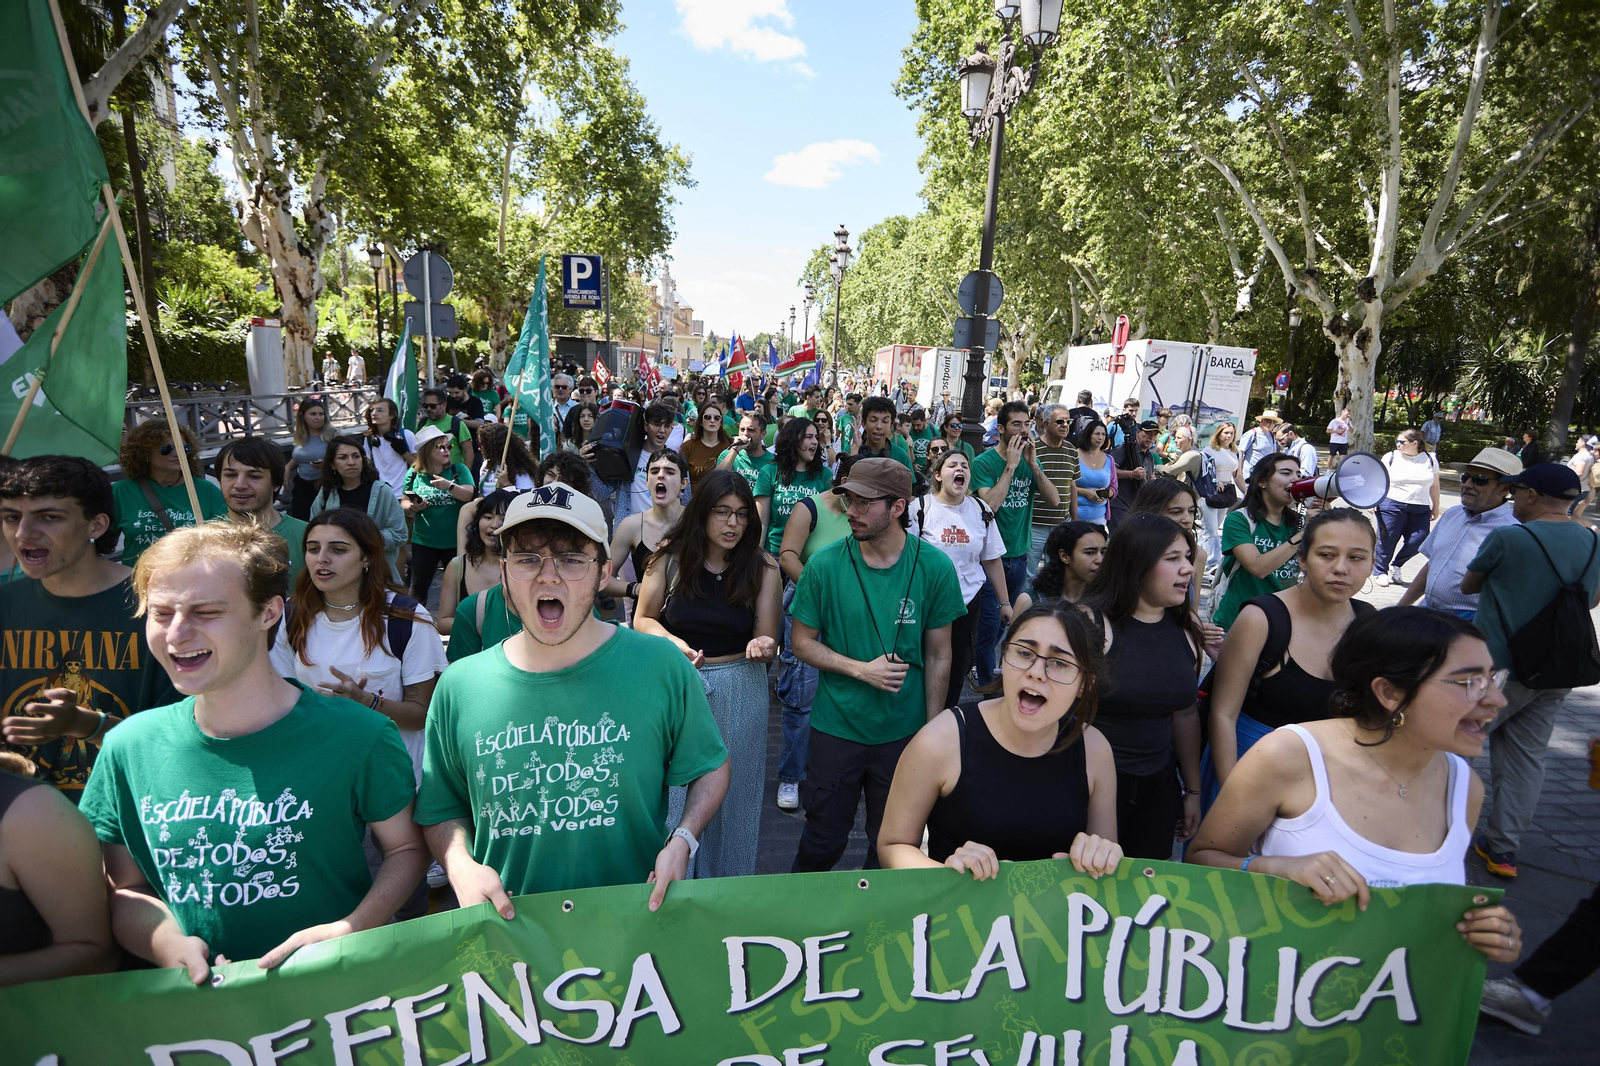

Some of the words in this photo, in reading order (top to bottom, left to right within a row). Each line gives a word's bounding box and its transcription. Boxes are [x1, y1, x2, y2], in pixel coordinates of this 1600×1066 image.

[571, 257, 593, 289] P
[1090, 356, 1110, 372] BARE
[1210, 356, 1244, 369] BAREA
[527, 486, 574, 510] M
[0, 629, 141, 670] NIRVANA
[475, 723, 554, 757] ESCUELA
[491, 771, 525, 796] DE
[529, 762, 611, 785] TOD@S
[141, 795, 226, 825] ESCUELA
[540, 794, 619, 819] TOD@S
[550, 815, 616, 832] Verde
[153, 847, 188, 868] DE
[193, 842, 287, 866] TOD@S
[202, 876, 300, 907] TOD@S
[722, 931, 860, 1013] DE
[911, 913, 1027, 1000] LA
[1065, 892, 1418, 1031] PÚBLICA
